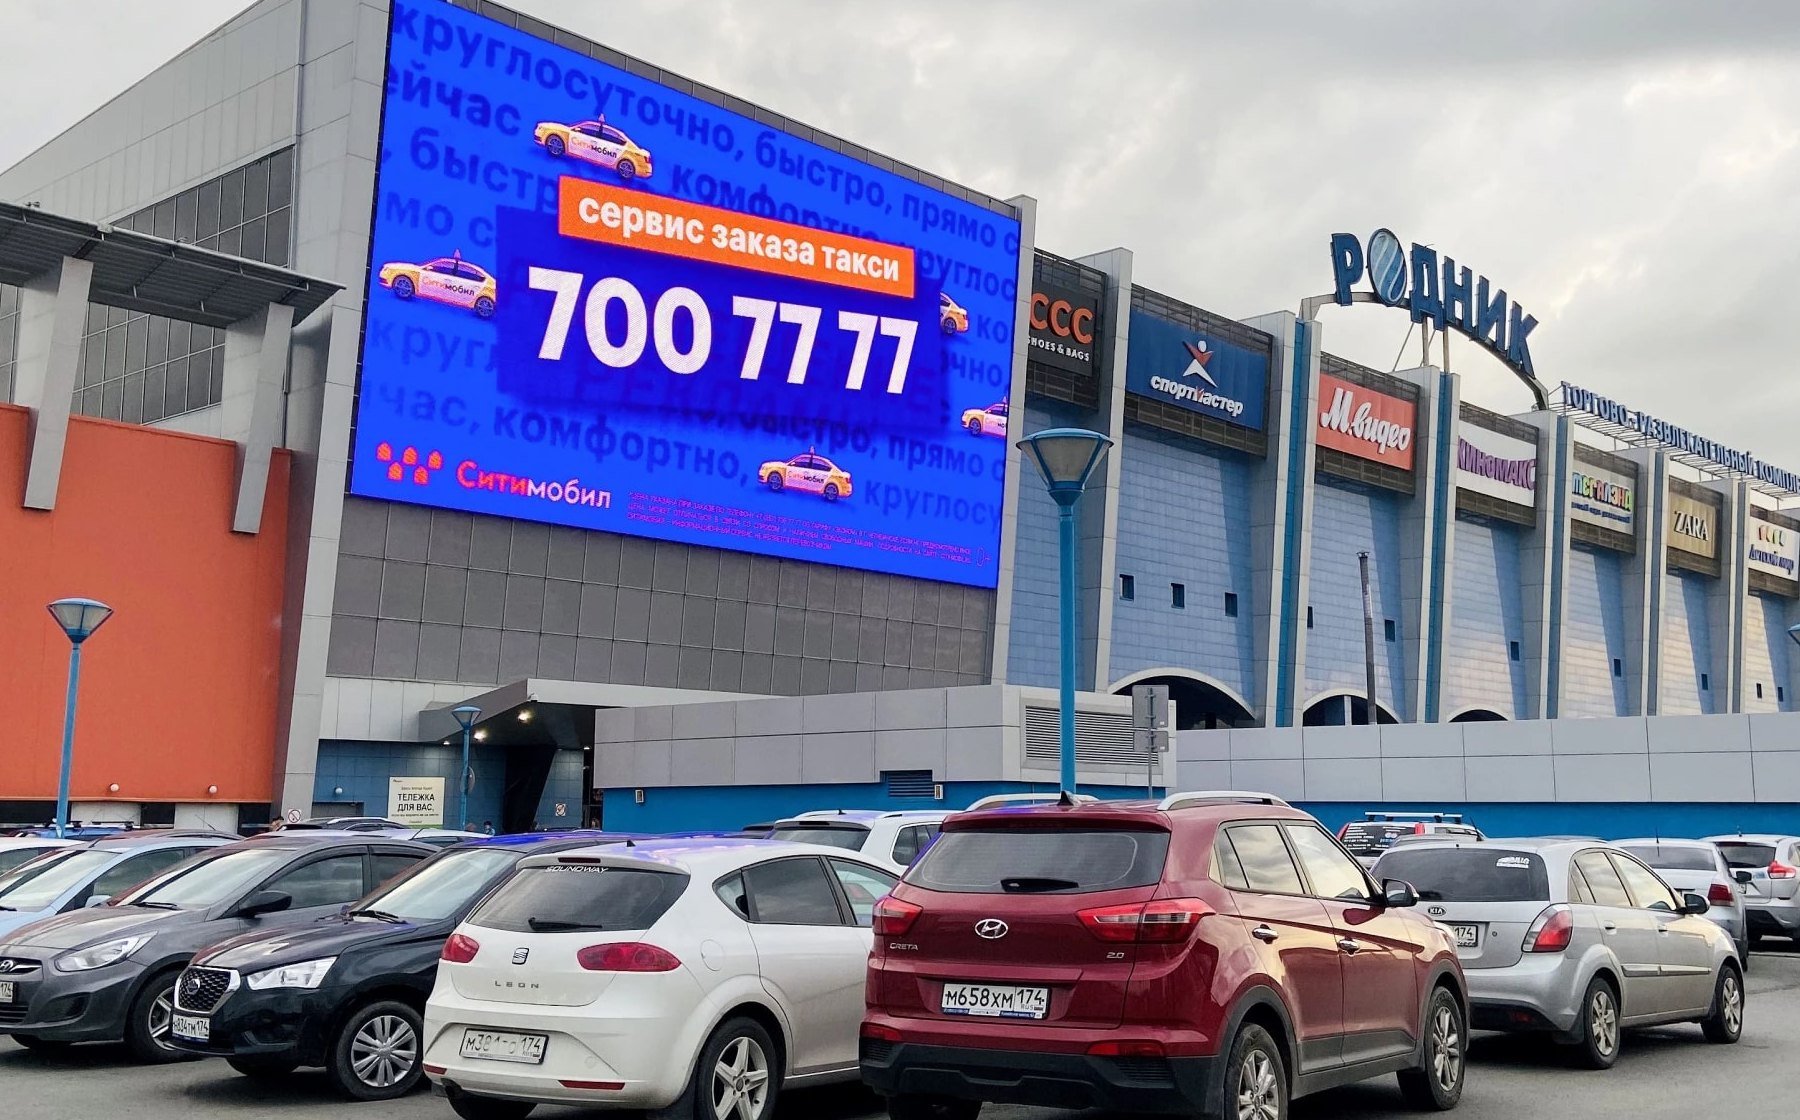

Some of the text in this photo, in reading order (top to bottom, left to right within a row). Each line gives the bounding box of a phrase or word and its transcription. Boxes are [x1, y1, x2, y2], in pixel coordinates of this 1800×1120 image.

[391, 3, 744, 162] круглосуточно,
[756, 131, 892, 215] быстро,
[902, 193, 997, 248] прямо
[578, 197, 900, 282] сервис заказа такси
[1330, 228, 1539, 379] РОДНИК
[529, 266, 919, 394] 700 77 77
[1057, 344, 1065, 354] &
[1065, 347, 1090, 362] BAGS
[494, 404, 748, 486] комфортно,
[1457, 434, 1536, 491] КИНОМАКС
[456, 460, 611, 509] Ситимобил
[1674, 510, 1709, 541] ZARA
[397, 793, 435, 801] ТЕЛЕЖКА
[397, 803, 415, 812] ДЛЯ
[1454, 926, 1472, 938] 174
[889, 942, 918, 951] CRETA
[494, 980, 540, 989] LEON
[946, 987, 1043, 1009] М658ХМ 174
[521, 1037, 541, 1053] 174
